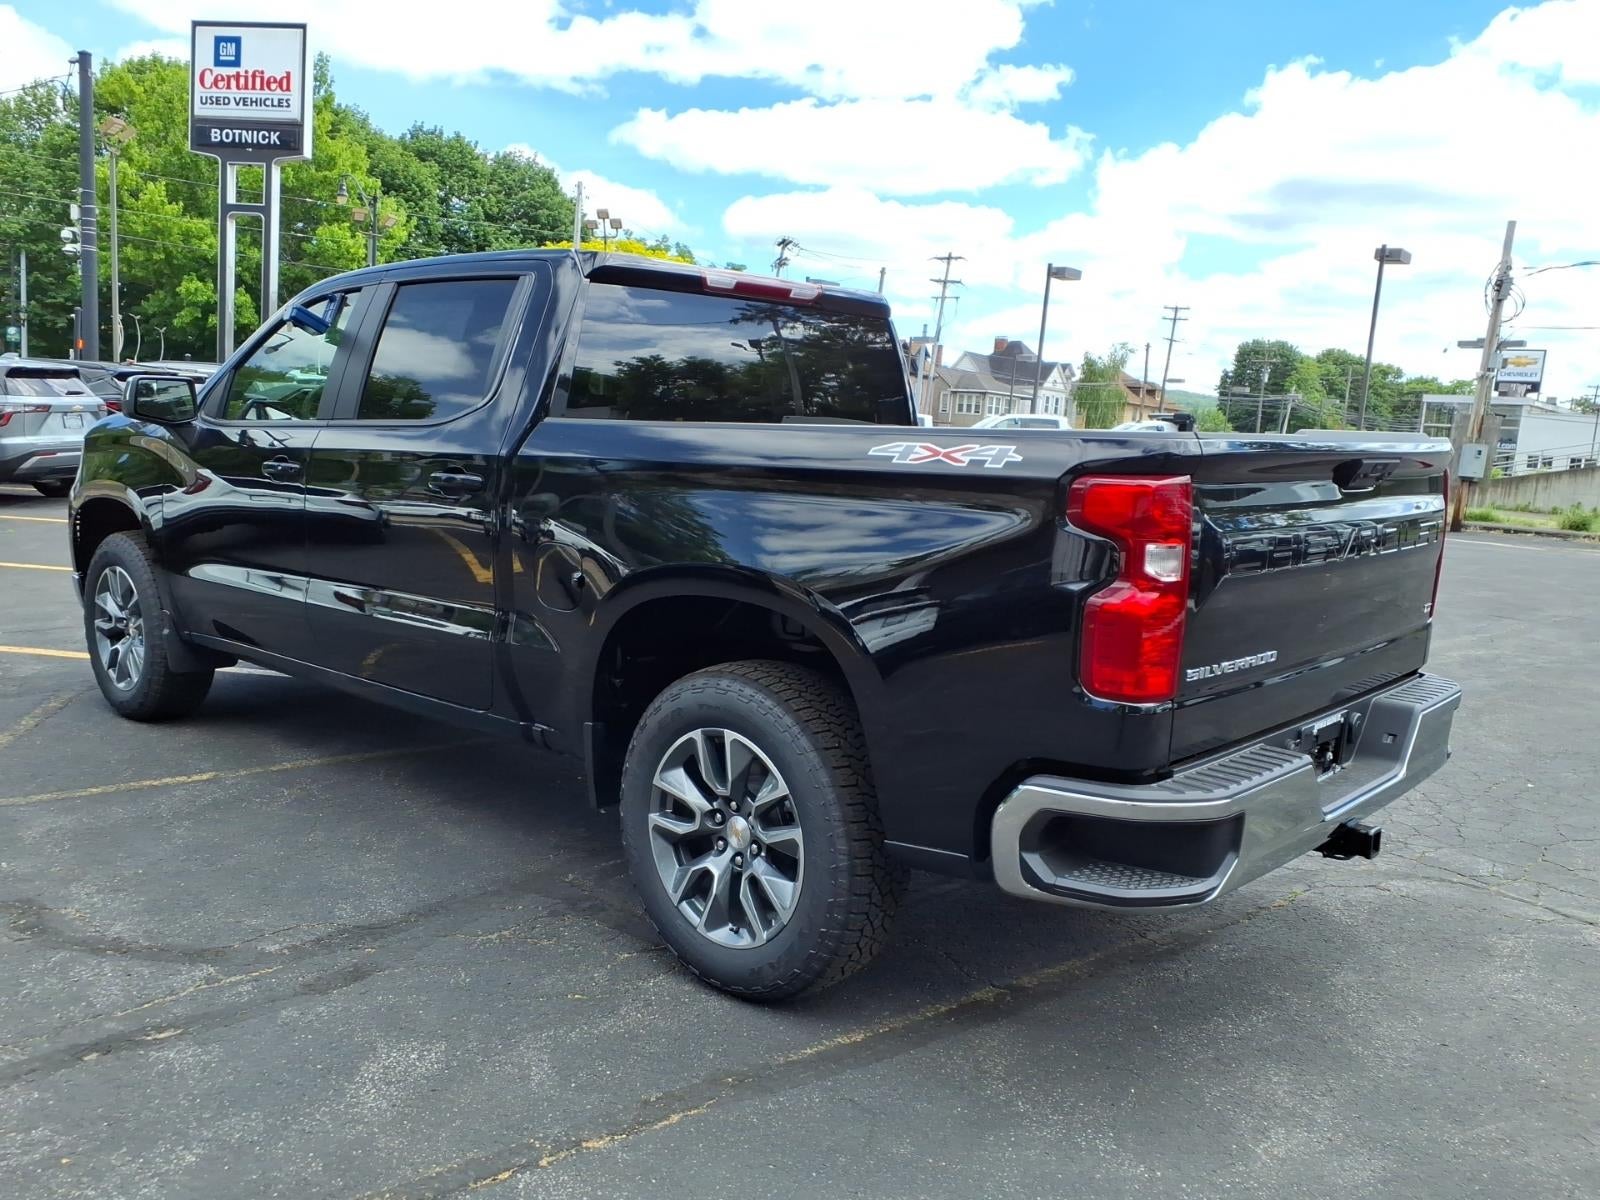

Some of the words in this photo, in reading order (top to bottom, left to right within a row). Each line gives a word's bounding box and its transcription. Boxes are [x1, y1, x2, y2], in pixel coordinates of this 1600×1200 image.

[219, 42, 236, 56] GM
[199, 68, 292, 93] Certified
[200, 96, 231, 106] USED
[233, 97, 291, 108] VEHICLES
[210, 128, 281, 145] BOTNICK
[1186, 650, 1278, 682] SILVERADO
